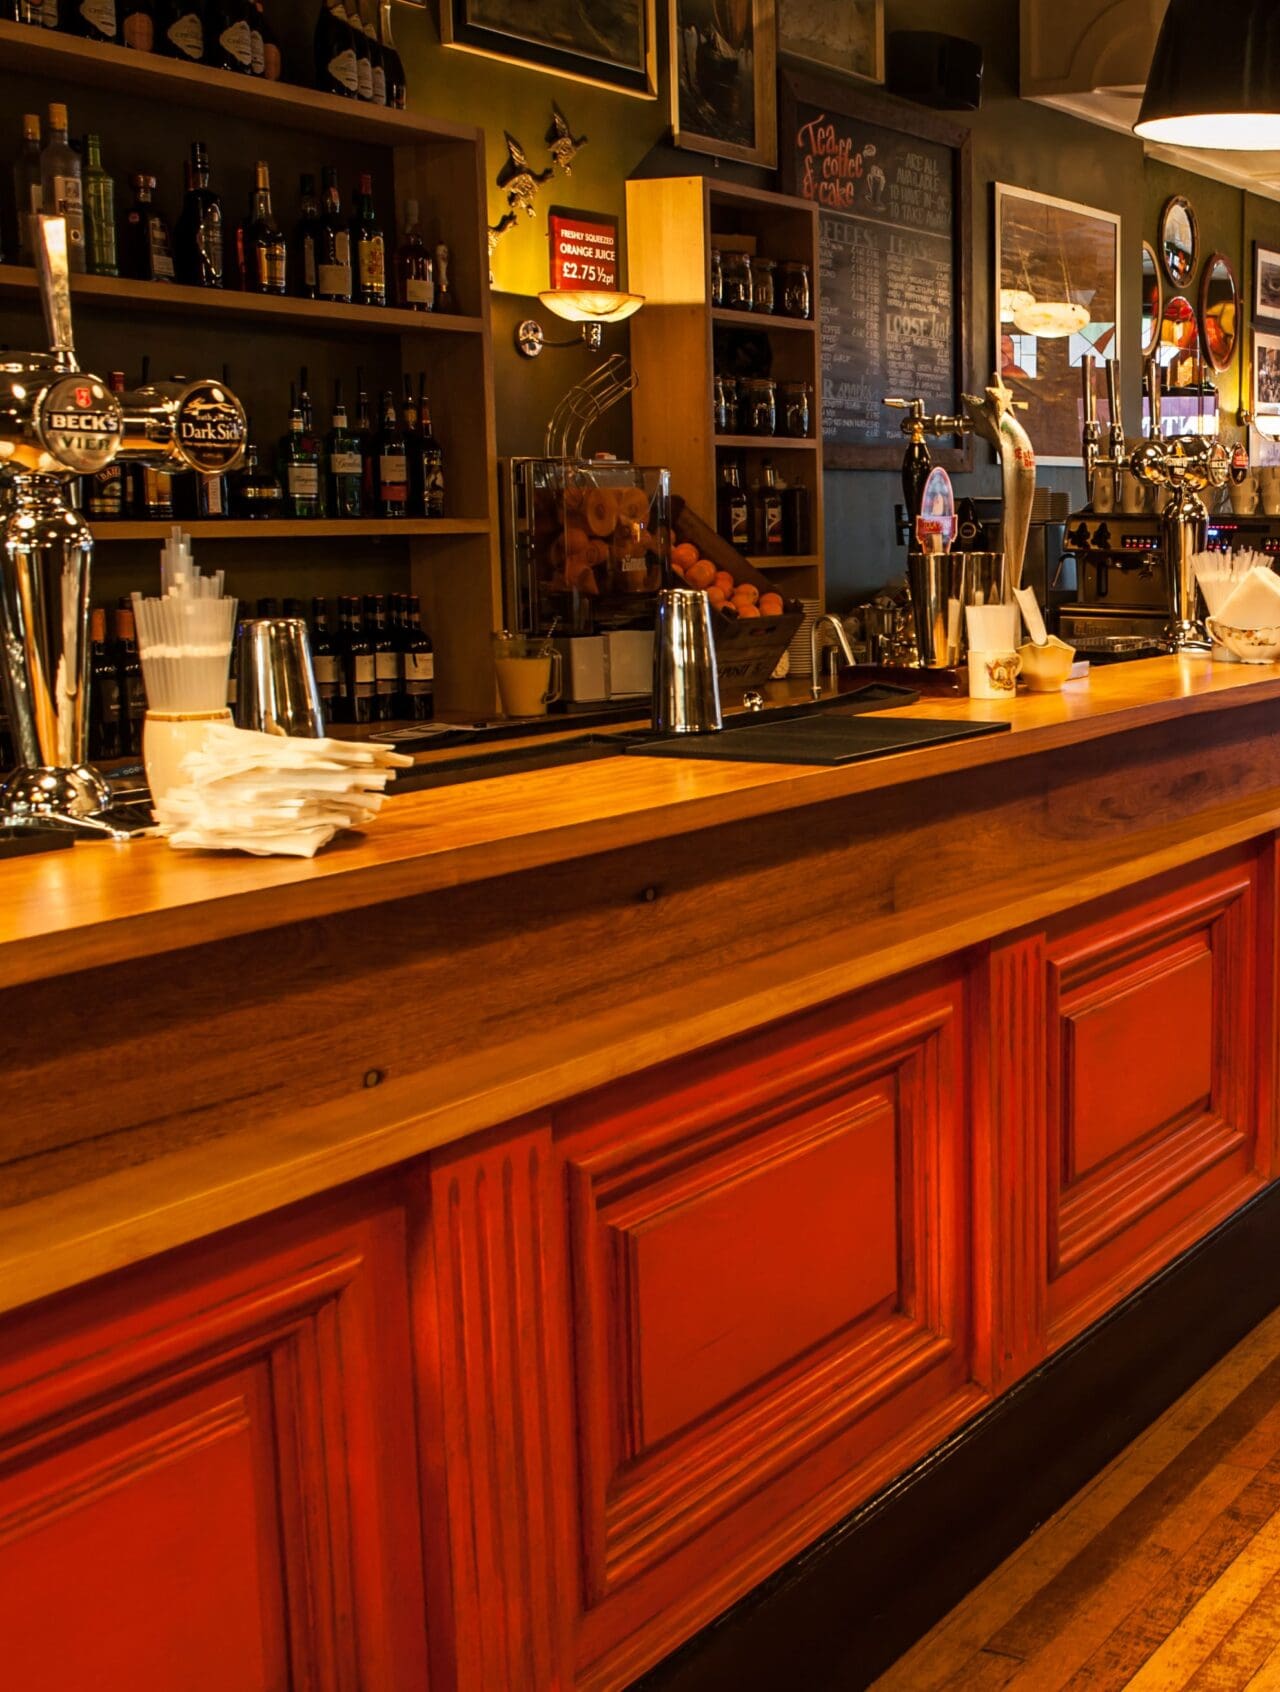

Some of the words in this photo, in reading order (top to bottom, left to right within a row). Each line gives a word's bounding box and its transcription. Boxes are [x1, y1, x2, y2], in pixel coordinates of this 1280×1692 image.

[818, 177, 855, 208] cake
[560, 229, 584, 241] FRESHLY
[585, 233, 615, 245] SQUEEZED
[560, 242, 594, 258] ORANGE
[594, 248, 616, 262] JUICE
[562, 261, 597, 281] £2.75
[886, 312, 930, 337] LOOSE
[52, 413, 118, 431] BECK'S
[181, 423, 216, 439] Dark
[62, 435, 111, 451] VIER
